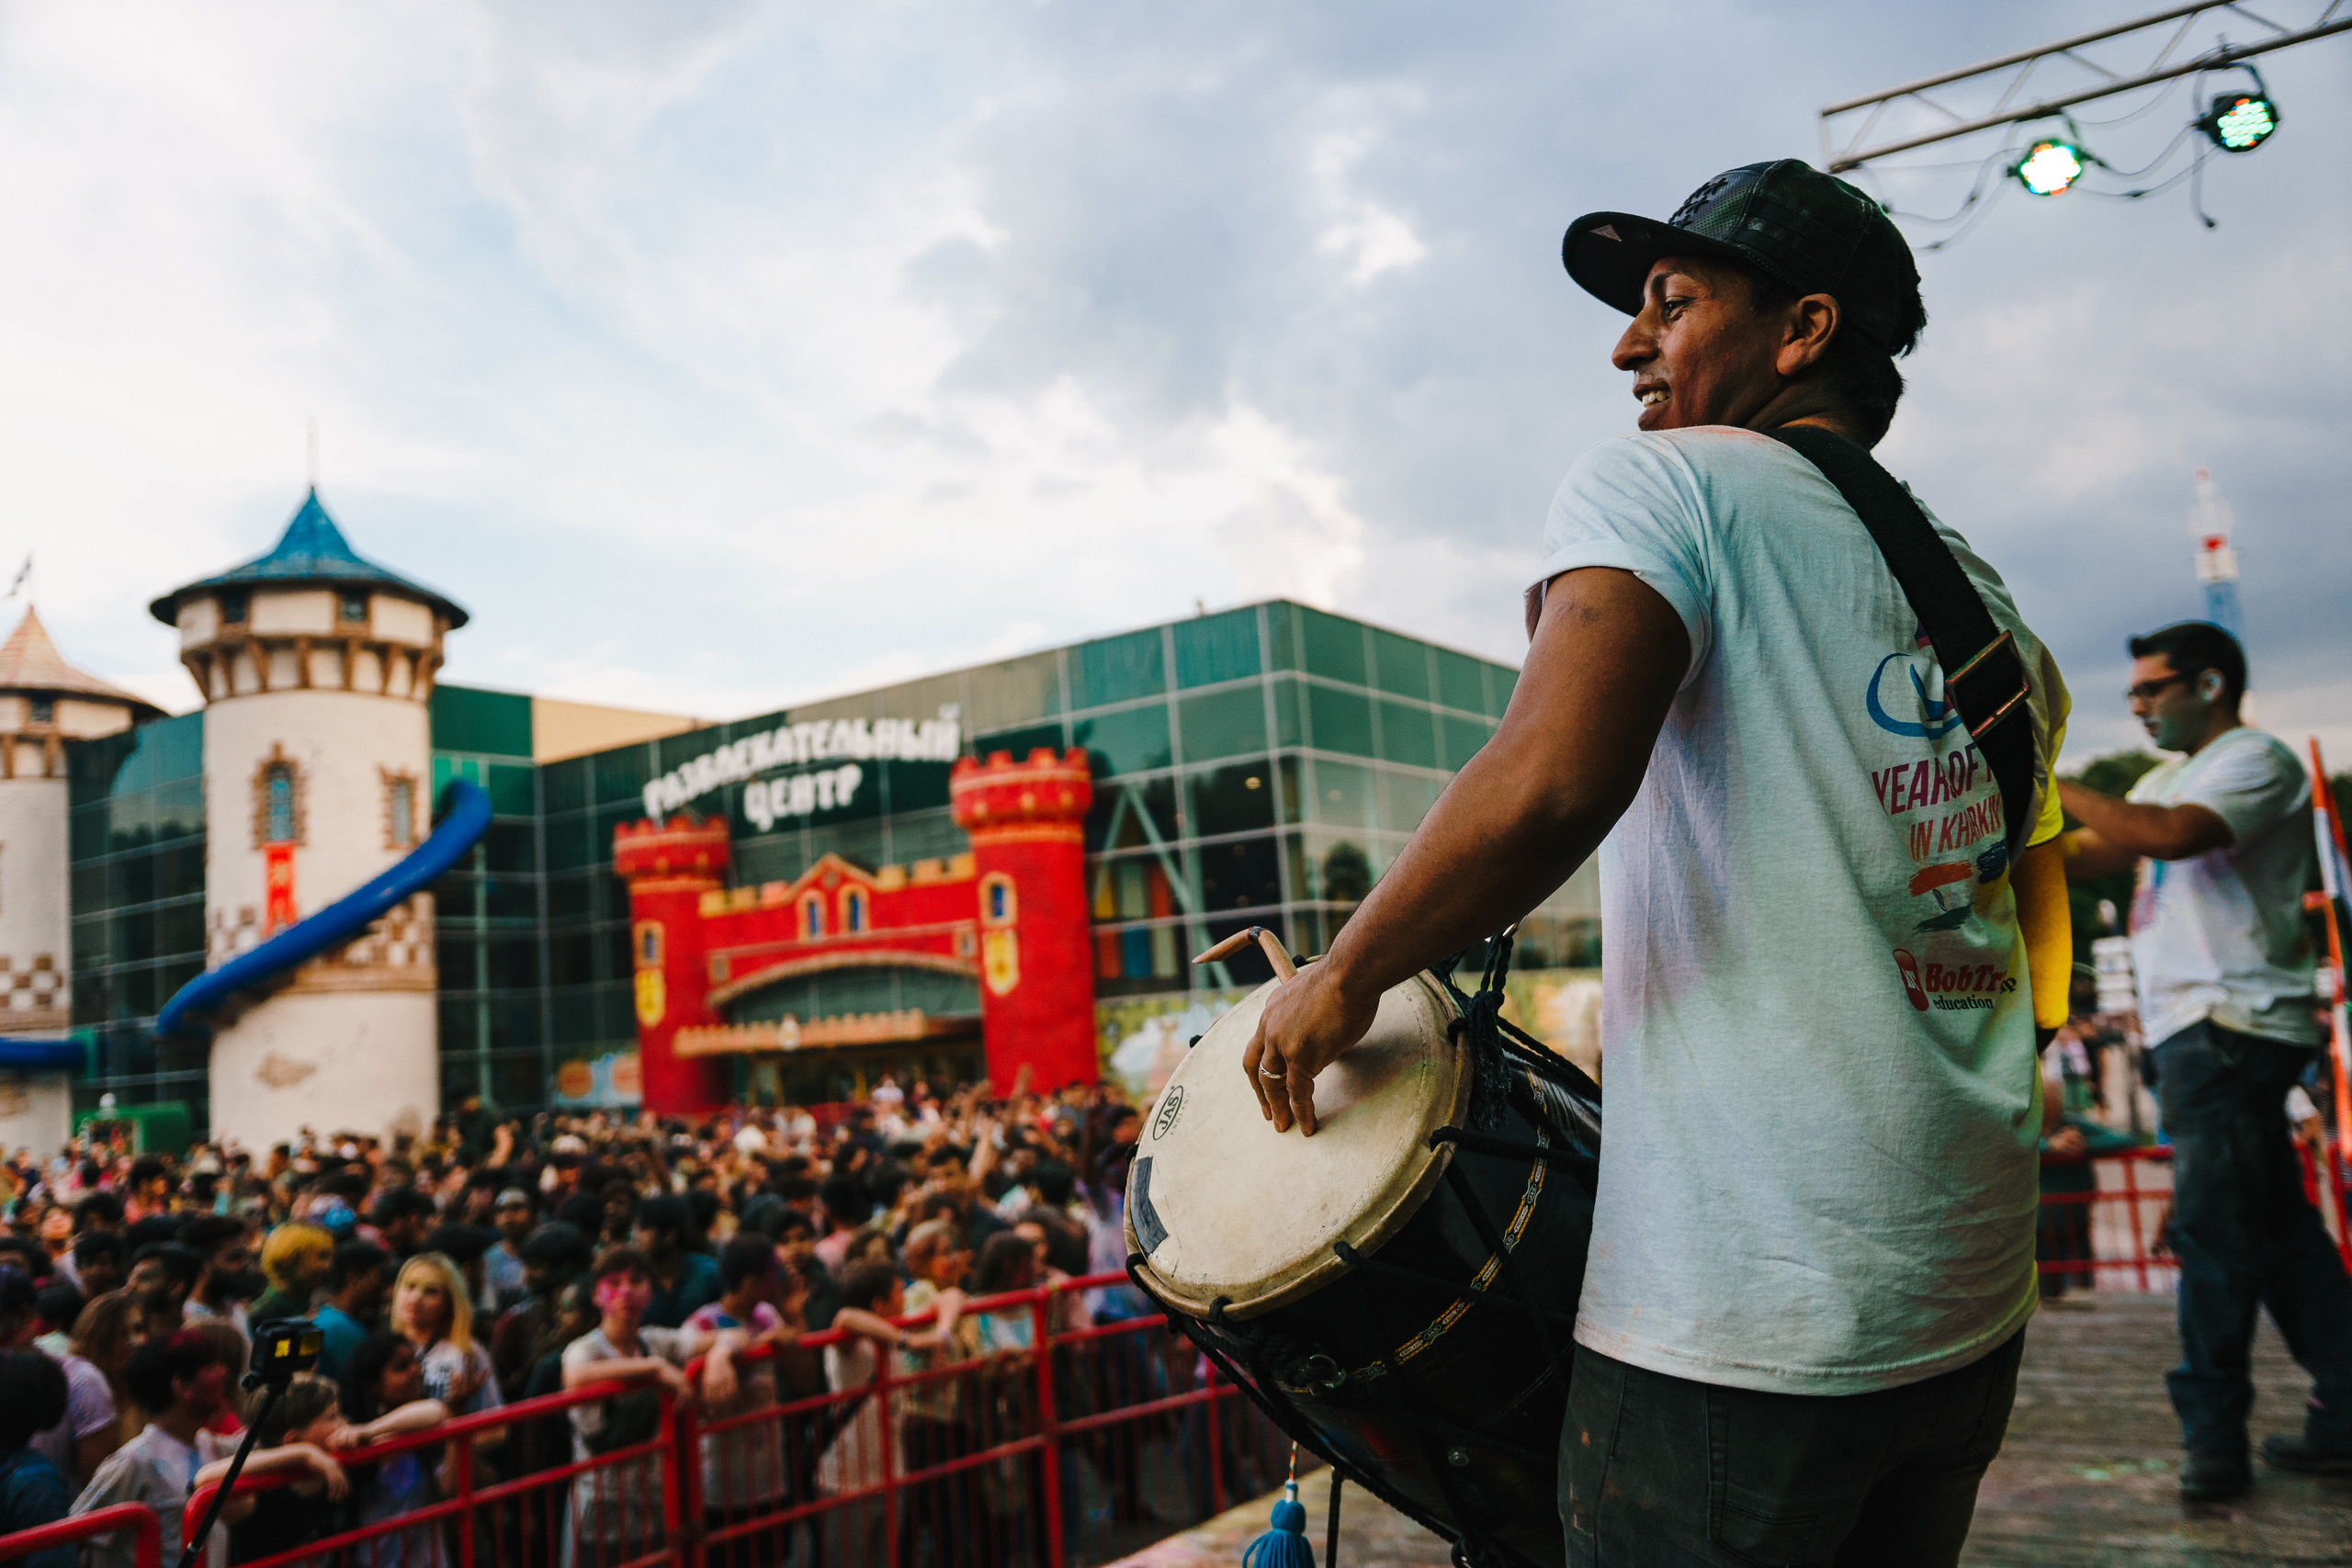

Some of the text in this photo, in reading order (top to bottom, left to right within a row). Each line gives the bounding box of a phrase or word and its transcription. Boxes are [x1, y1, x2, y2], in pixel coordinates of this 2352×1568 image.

[743, 762, 863, 833] ЦЕНТР
[1909, 818, 1935, 861] IN
[1932, 994, 1995, 1011] education
[1158, 1095, 1180, 1131] JAS
